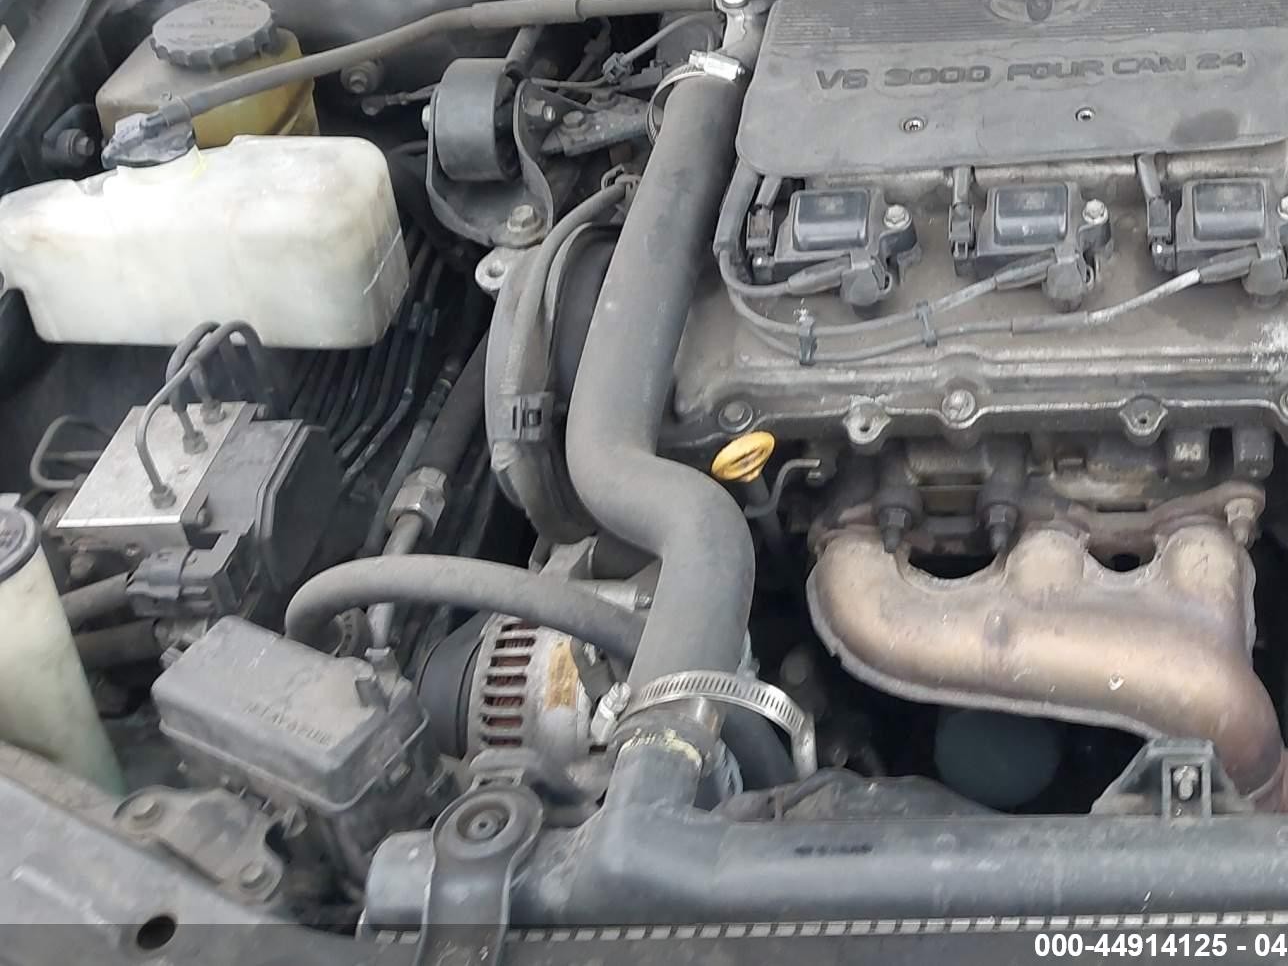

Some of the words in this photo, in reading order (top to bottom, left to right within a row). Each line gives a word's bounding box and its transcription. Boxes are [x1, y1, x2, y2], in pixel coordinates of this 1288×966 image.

[814, 68, 869, 91] V6
[883, 64, 992, 88] 3000
[1006, 60, 1105, 82] FOUR
[1111, 55, 1187, 75] CAM
[1196, 51, 1248, 71] 24
